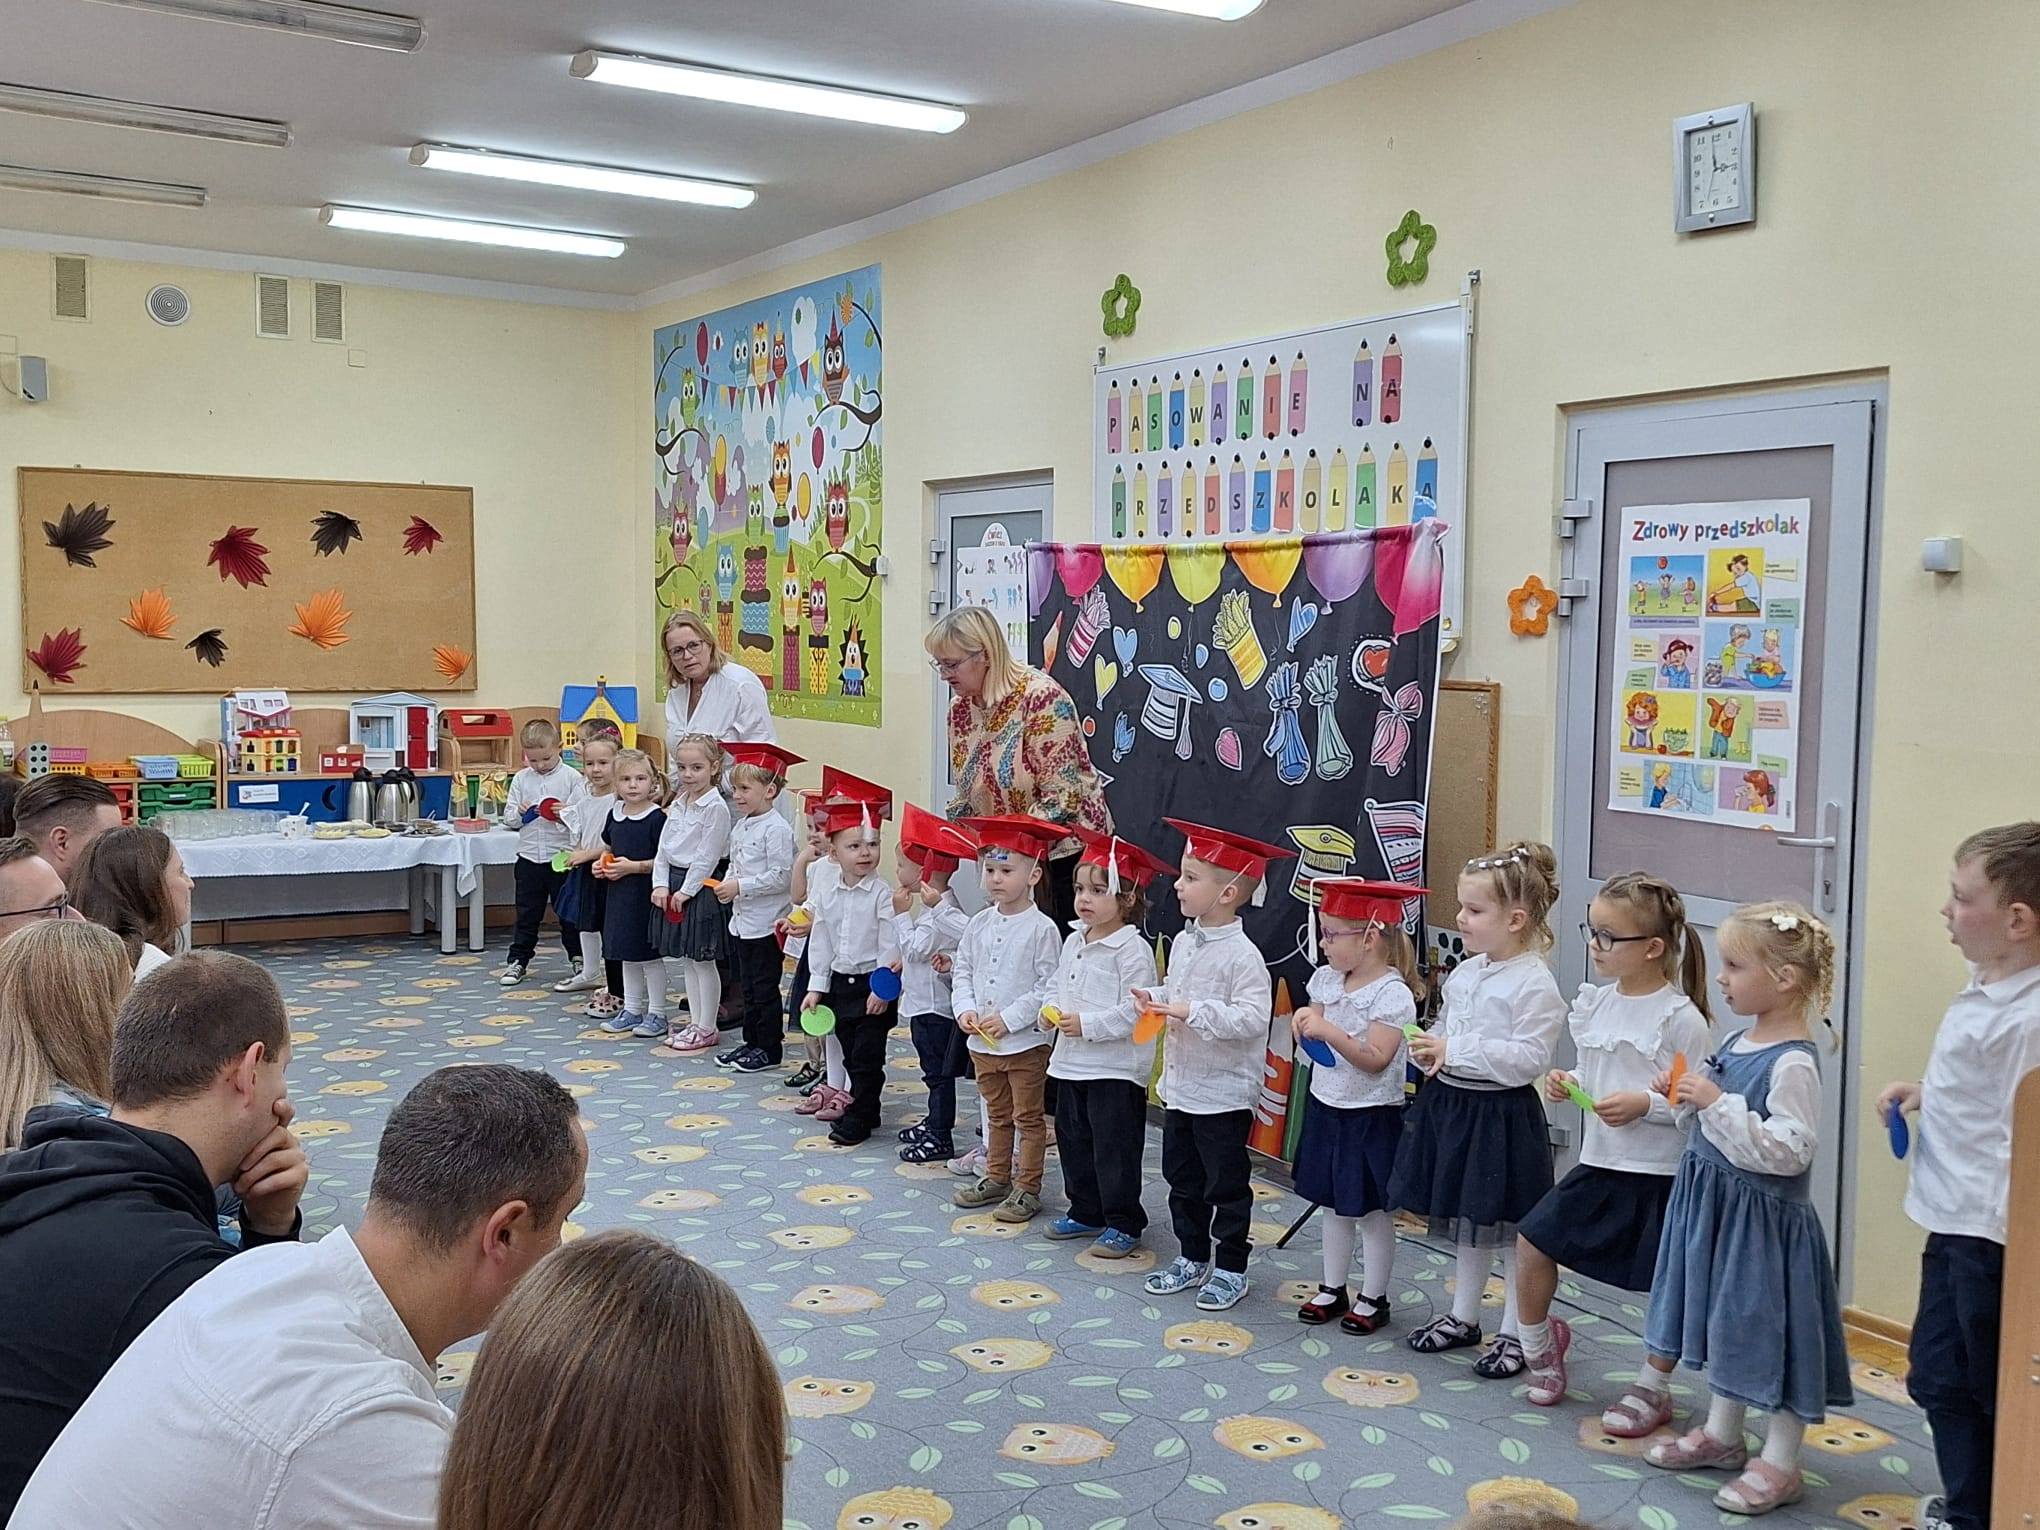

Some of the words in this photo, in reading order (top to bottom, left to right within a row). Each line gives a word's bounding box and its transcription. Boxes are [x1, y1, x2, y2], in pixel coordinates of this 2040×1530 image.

[1109, 393, 1301, 434] PASOWANIE
[1356, 377, 1398, 402] NA
[1115, 482, 1433, 517] PRZEDSZKOLAKA
[1632, 519, 1689, 542] Zdrowy
[1694, 512, 1800, 542] przedszkolak
